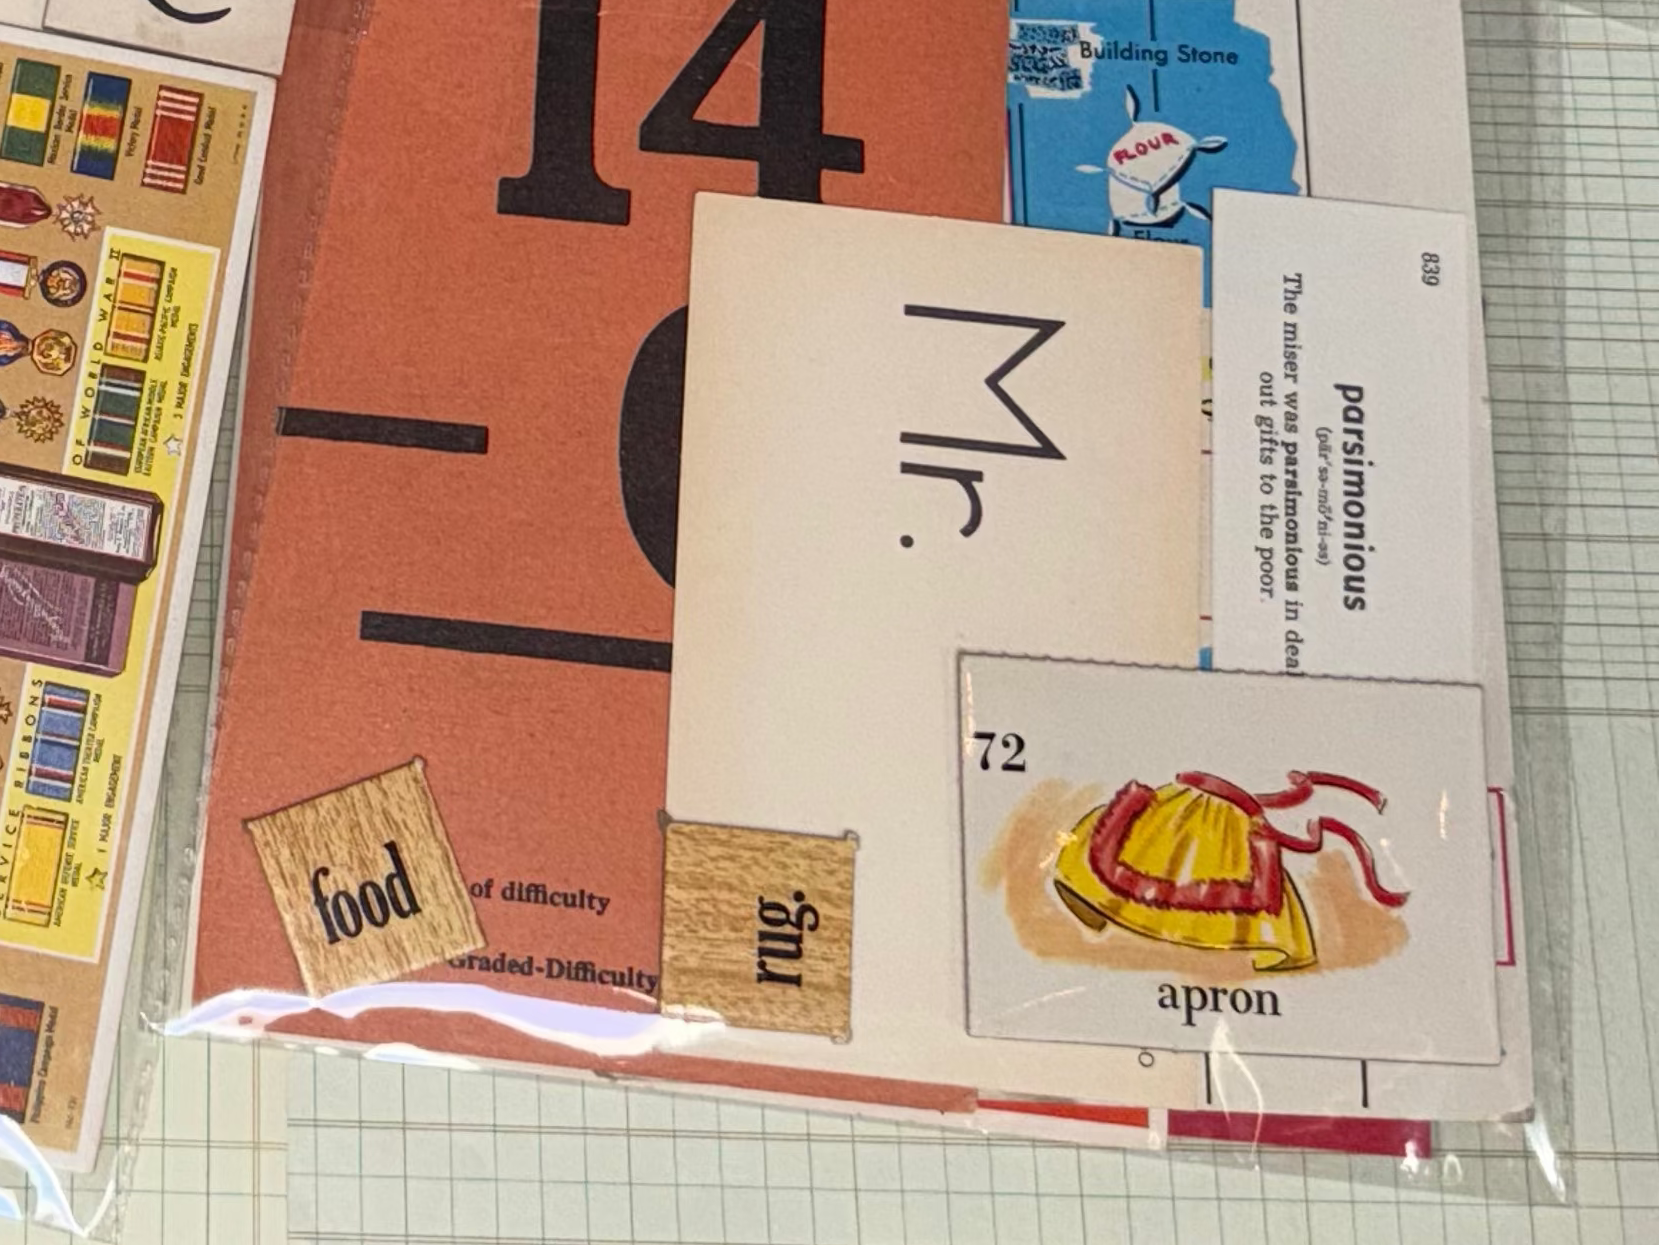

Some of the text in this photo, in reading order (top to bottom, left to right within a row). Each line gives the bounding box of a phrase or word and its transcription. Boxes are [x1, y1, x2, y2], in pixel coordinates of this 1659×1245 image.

[1079, 40, 1239, 65] Building Stone
[1112, 131, 1181, 166] FLOUR
[1420, 251, 1441, 286] 839
[1283, 272, 1303, 316] The
[71, 276, 114, 466] OF WORLD WAR
[1283, 319, 1302, 383] miser
[897, 304, 1067, 549] Mr.
[1284, 390, 1300, 435] was
[1255, 371, 1275, 602] out gifts to the poor.
[1334, 383, 1375, 613] parsimonious
[1279, 440, 1304, 592] parsimonious
[1285, 600, 1302, 624] in
[15, 677, 42, 789] RIBBONS
[973, 731, 1027, 772] 72
[98, 813, 112, 843] MAJOR
[310, 840, 422, 946] food
[471, 880, 611, 916] of difficulty
[755, 888, 820, 989] rug.
[449, 949, 659, 994] Graded-Difficulty
[1157, 979, 1283, 1026] apron
